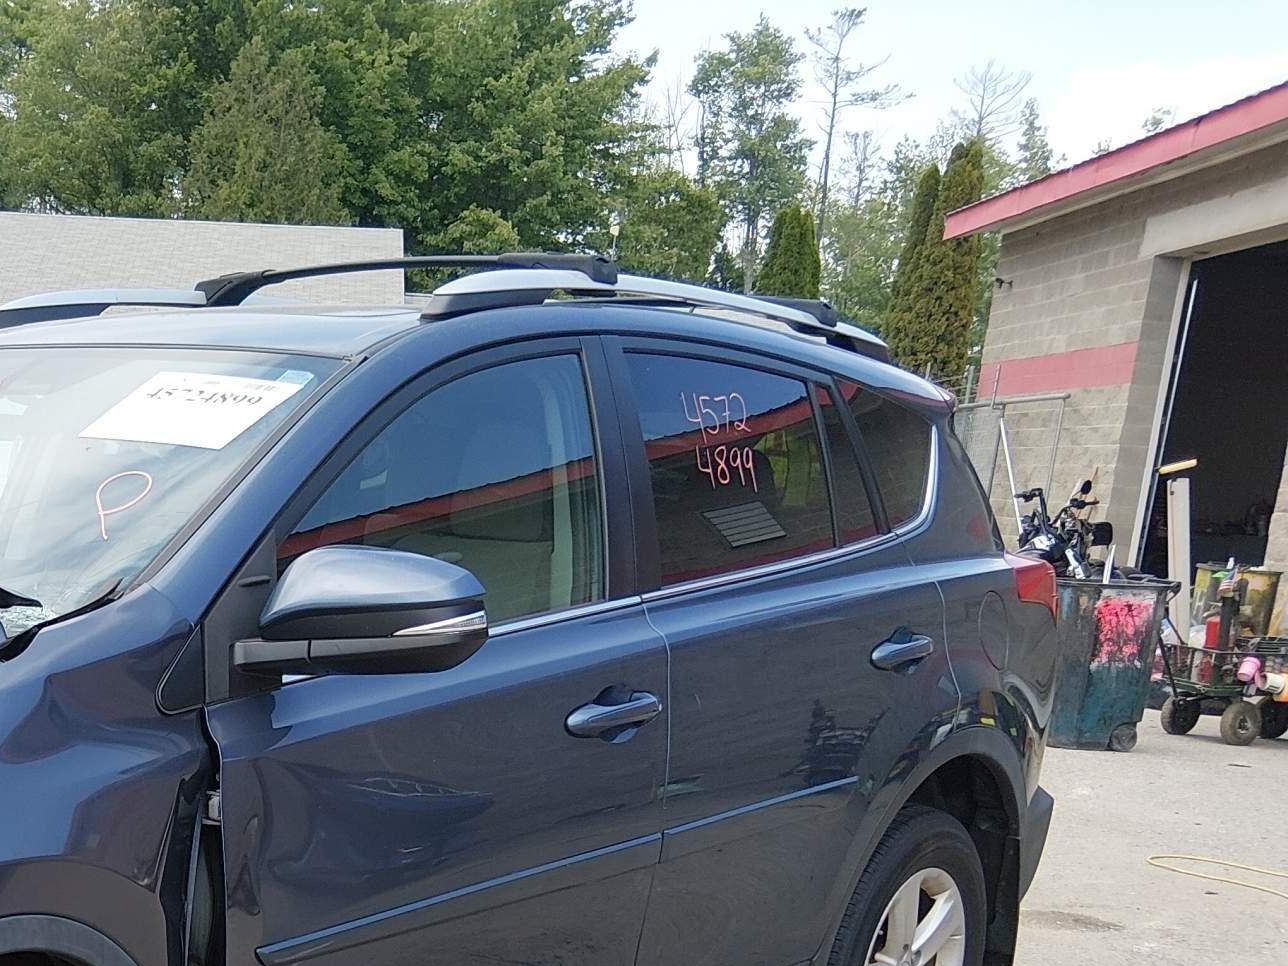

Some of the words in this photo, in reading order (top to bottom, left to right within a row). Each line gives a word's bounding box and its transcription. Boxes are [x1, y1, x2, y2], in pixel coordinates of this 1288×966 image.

[679, 391, 752, 444] 4572
[695, 444, 759, 493] 4899
[95, 470, 153, 540] P
